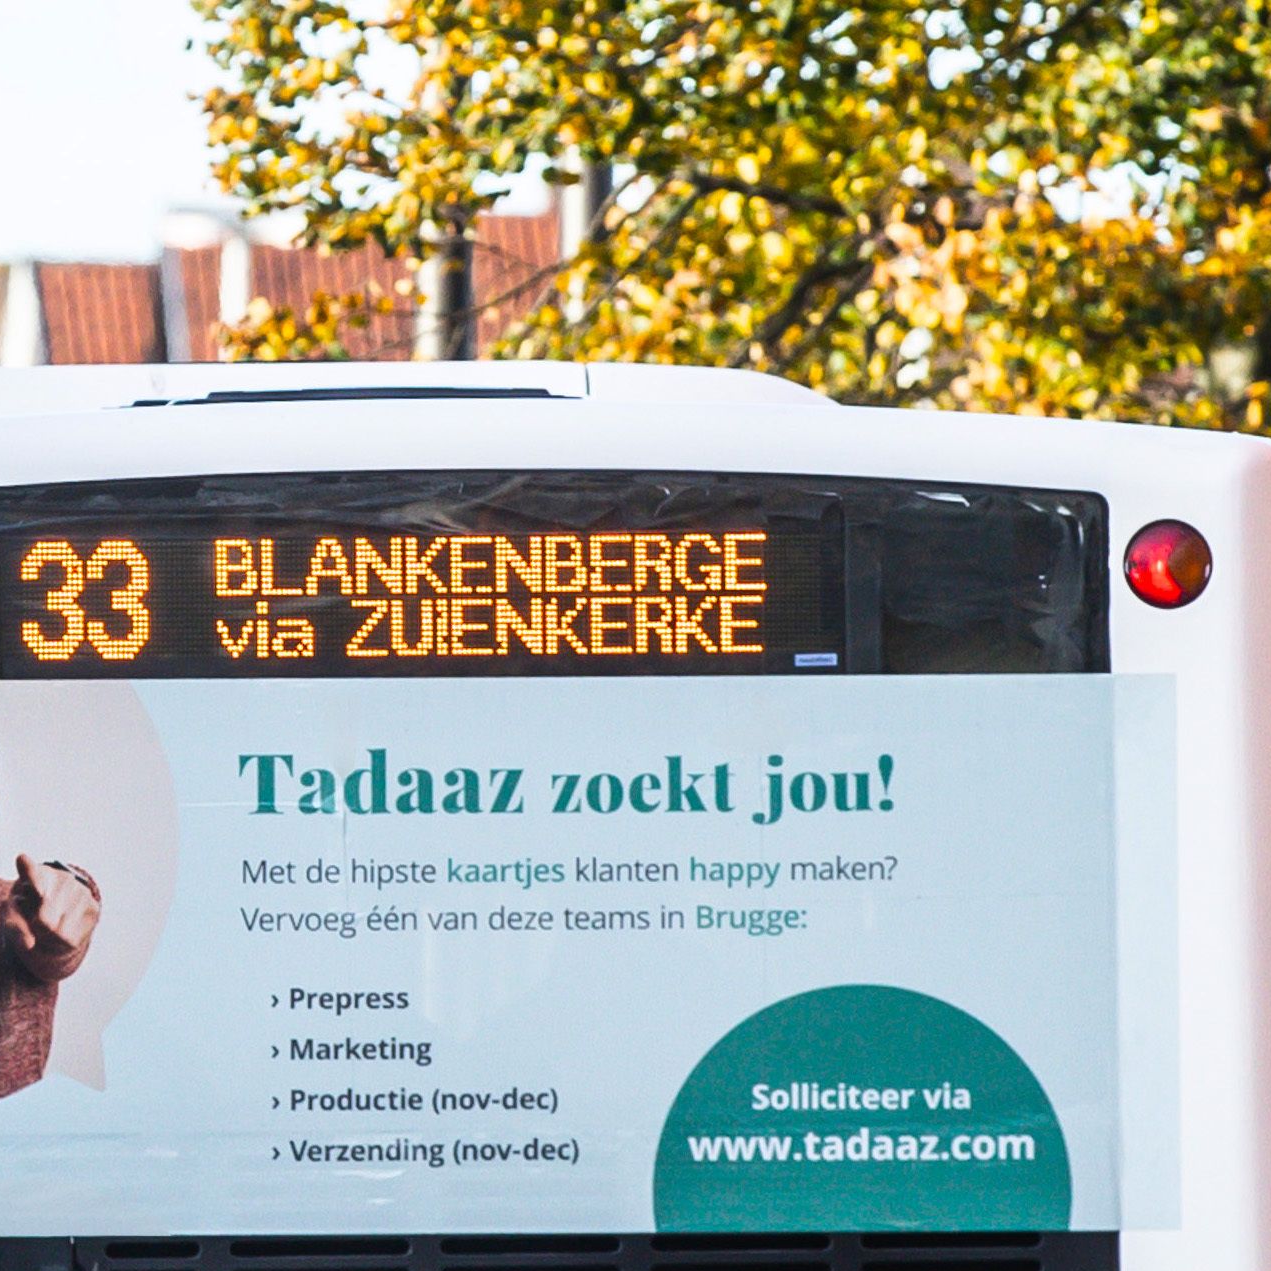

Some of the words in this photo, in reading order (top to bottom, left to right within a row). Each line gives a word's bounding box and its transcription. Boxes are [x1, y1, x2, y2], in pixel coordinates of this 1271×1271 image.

[212, 531, 768, 598] BLANKENBERGE
[20, 537, 152, 661] 33
[215, 600, 316, 660] via
[345, 595, 766, 659] ZUIENKERKE
[238, 748, 525, 816] Tadaaz
[551, 755, 734, 815] zoekt
[752, 753, 896, 826] jou!
[241, 859, 296, 885] Met
[305, 858, 341, 884] de
[350, 858, 437, 891] hipste
[447, 857, 566, 890] kaartjes
[575, 856, 680, 883] klanten
[690, 856, 781, 889] happy
[790, 855, 898, 882] maken?
[240, 906, 357, 939] Vervoeg
[366, 904, 419, 932] één
[427, 911, 479, 931] van
[488, 905, 555, 931] deze
[563, 908, 651, 931] teams
[660, 905, 686, 930] in
[696, 905, 808, 937] Brugge:
[290, 987, 410, 1017] Prepress
[290, 1037, 432, 1067] Marketing
[290, 1087, 424, 1112] Productie
[431, 1087, 559, 1116] (nov-dec)
[751, 1082, 914, 1112] Solliciteer
[922, 1082, 972, 1111] via
[289, 1138, 446, 1168] Verzending
[453, 1138, 580, 1167] (nov-dec)
[687, 1127, 1036, 1164] www.tadaaz.com
